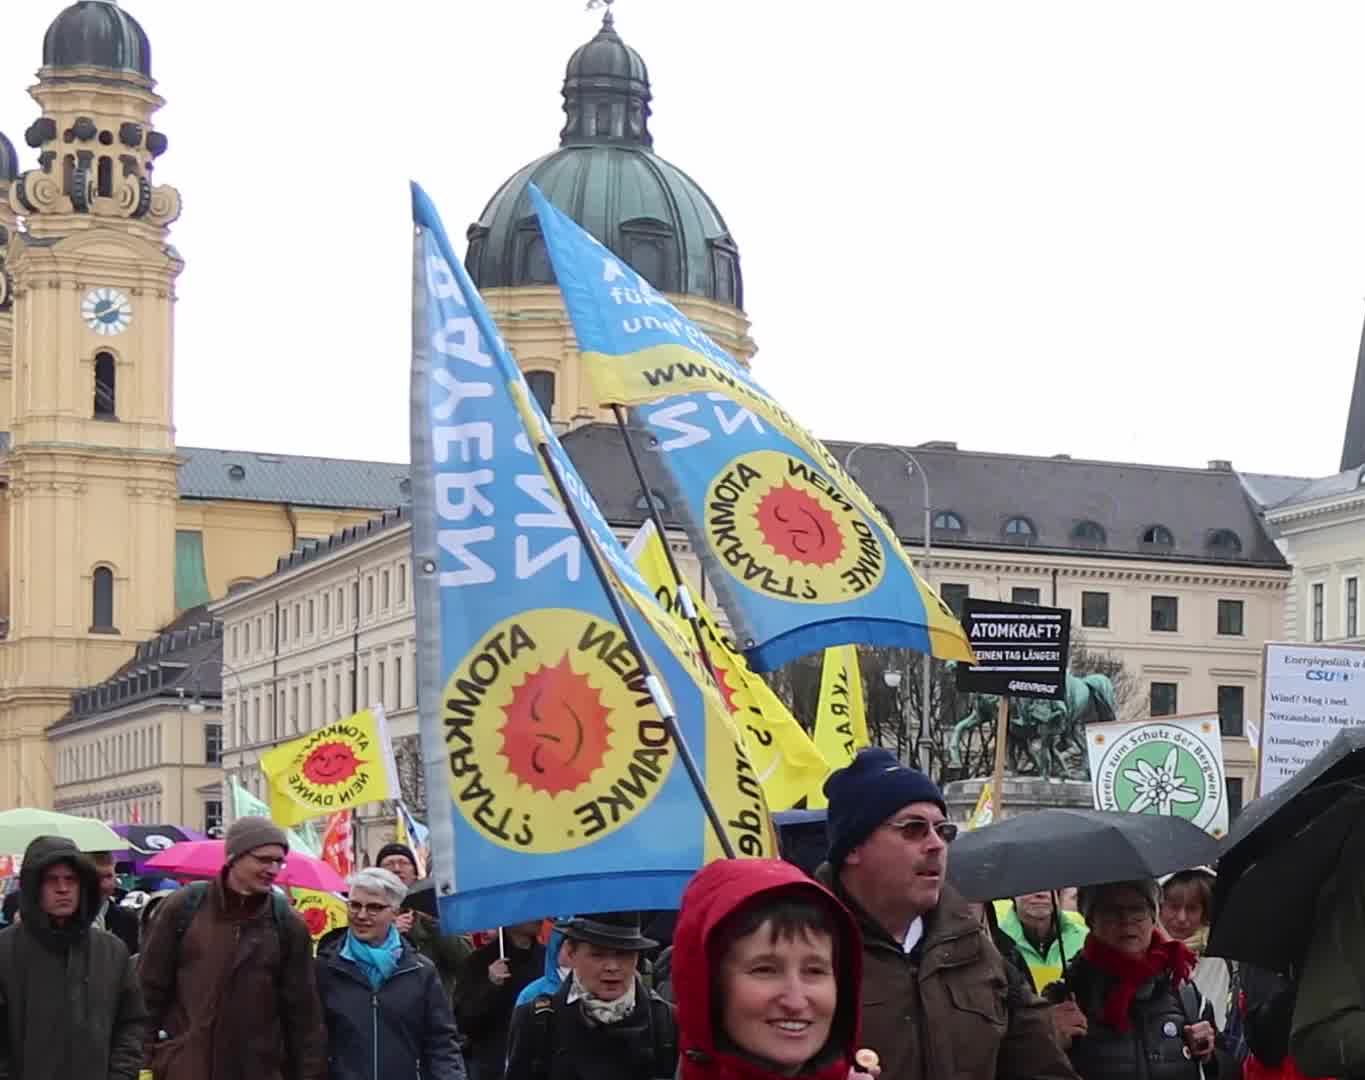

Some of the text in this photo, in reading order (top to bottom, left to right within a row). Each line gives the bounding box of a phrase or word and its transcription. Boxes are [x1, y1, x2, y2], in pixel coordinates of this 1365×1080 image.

[970, 623, 1061, 638] ATOMKRAFT?
[974, 648, 1060, 661] EINEN TAG LÄNGER!
[1305, 670, 1335, 681] CSU
[1109, 744, 1129, 768] zum
[1130, 730, 1169, 746] Schutz
[1174, 732, 1194, 746] der
